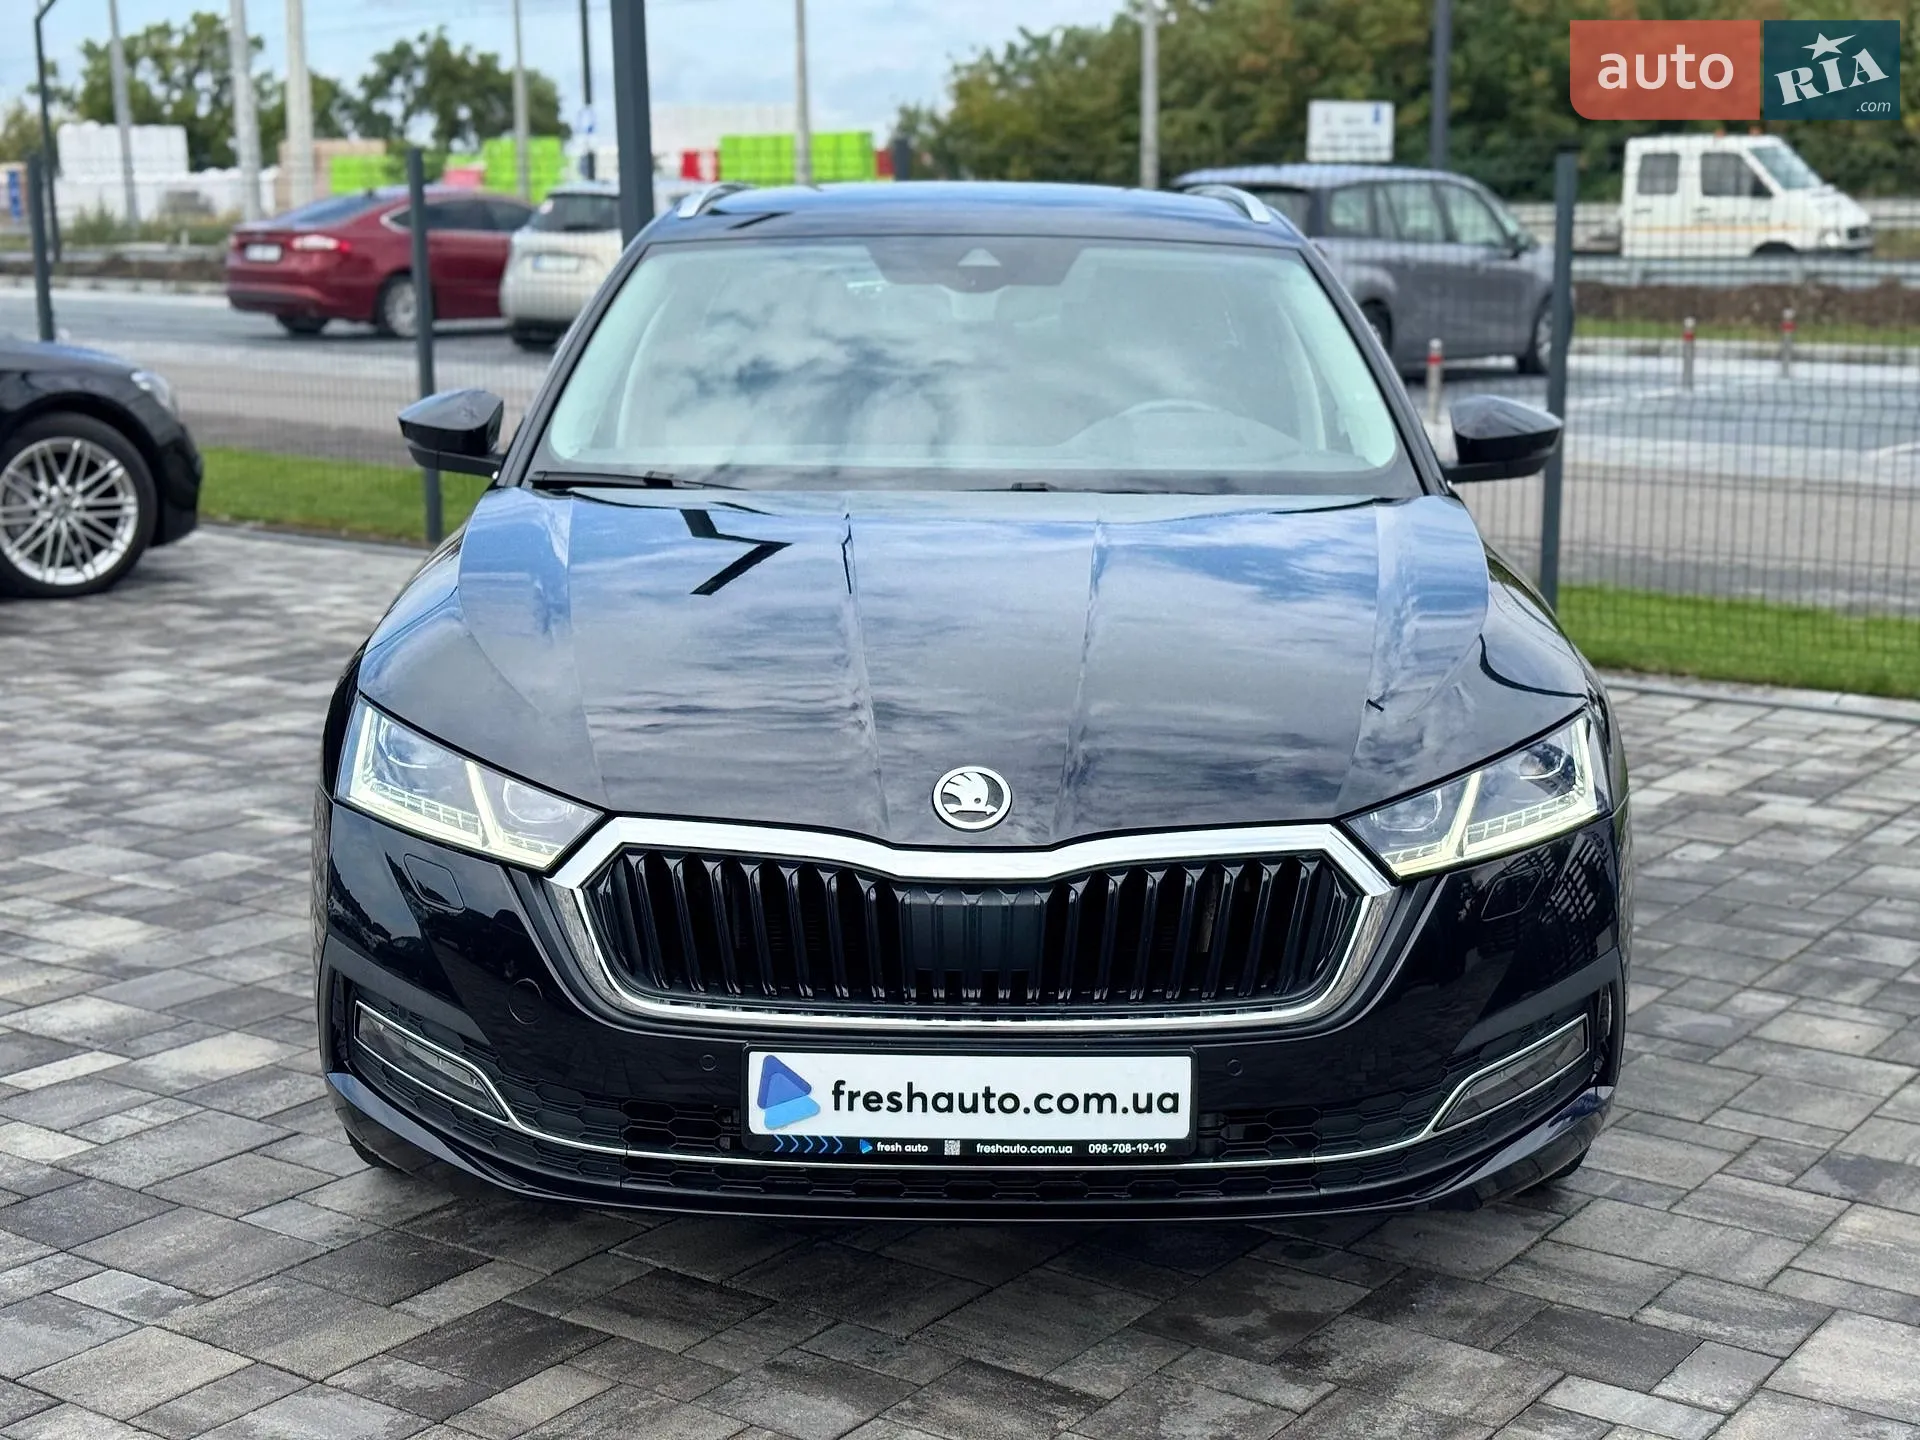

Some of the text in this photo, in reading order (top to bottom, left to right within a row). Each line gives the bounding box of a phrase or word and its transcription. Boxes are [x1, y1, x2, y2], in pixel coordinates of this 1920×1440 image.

[832, 1079, 1180, 1114] freshauto.com.ua
[876, 1142, 1167, 1156] fresh auto freshauto.com.ua 098-708-19-19
